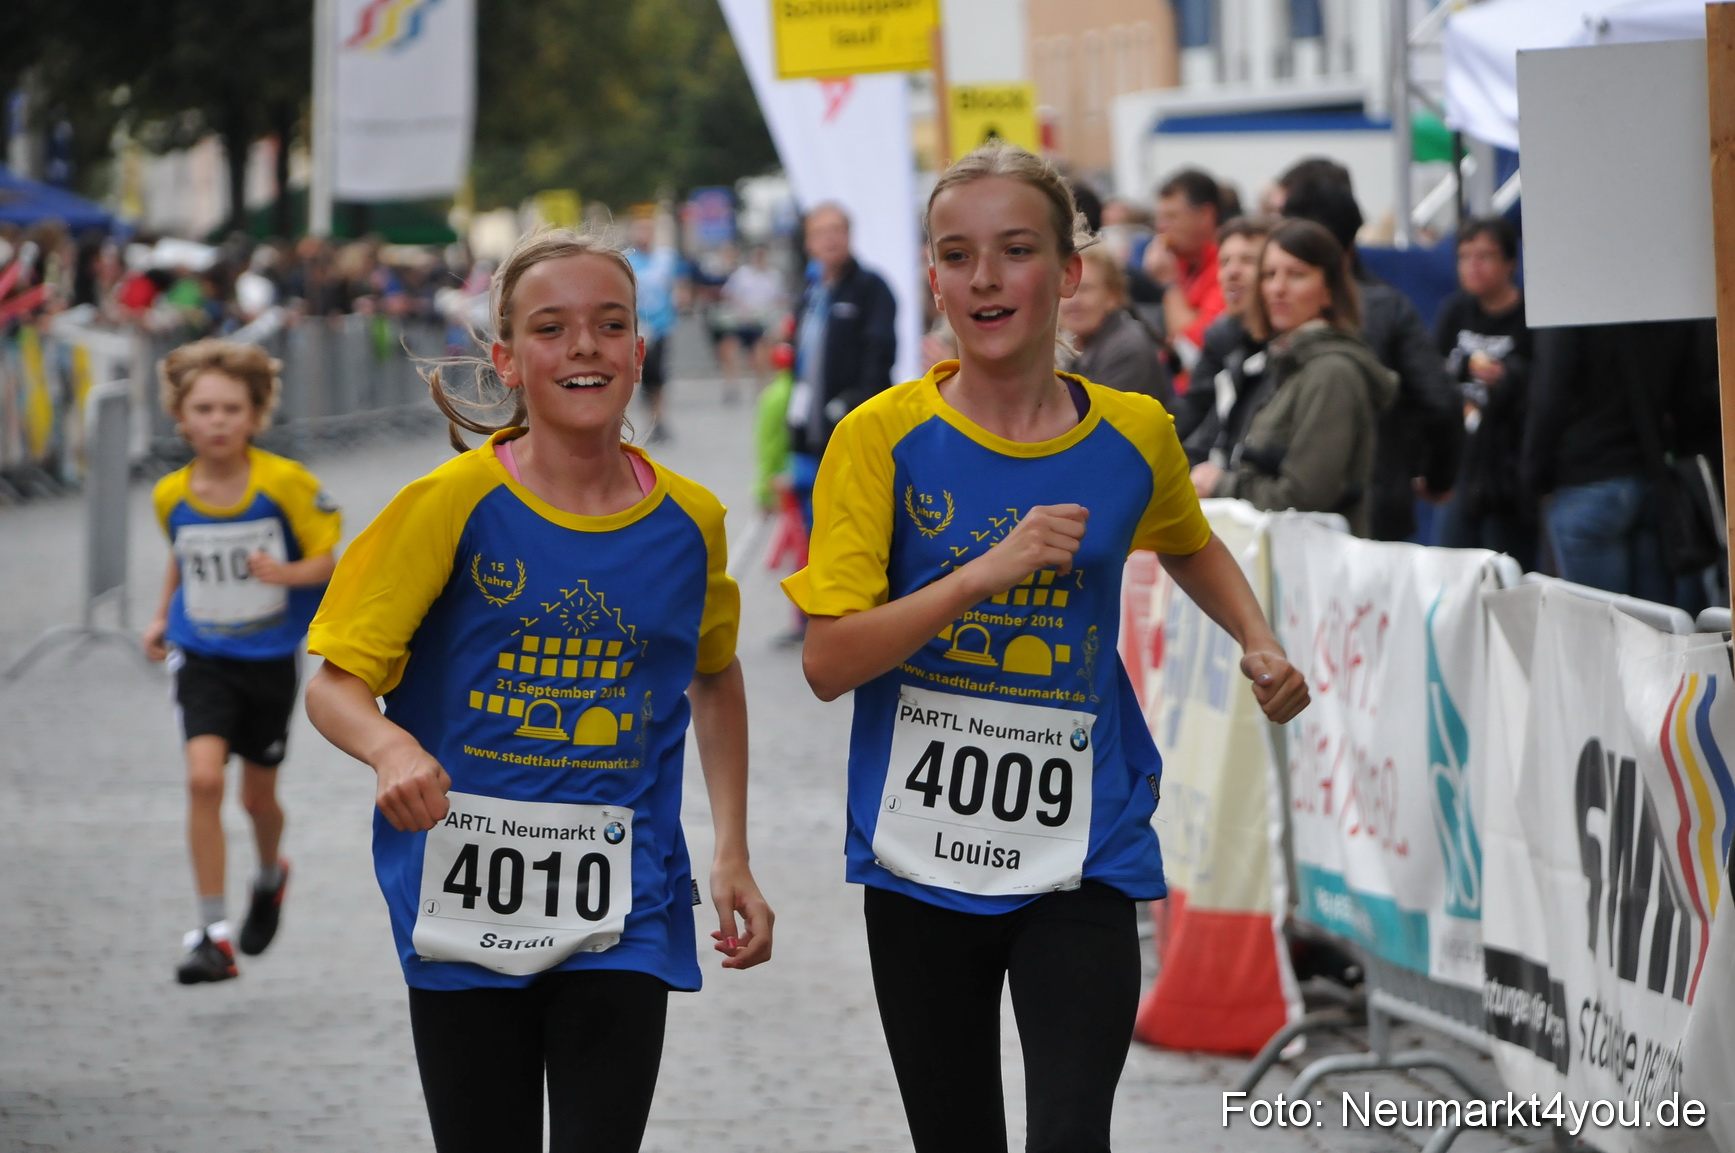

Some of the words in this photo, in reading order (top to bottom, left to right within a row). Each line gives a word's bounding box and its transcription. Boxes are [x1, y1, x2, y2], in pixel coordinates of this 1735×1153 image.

[918, 493, 933, 504] 15
[916, 505, 942, 519] Jahre
[491, 562, 505, 573] 15
[482, 573, 513, 588] Jahre
[958, 610, 1028, 627] ptember
[1030, 614, 1064, 629] 2014
[496, 678, 596, 699] 21.September
[900, 705, 963, 732] PARTL
[968, 717, 1063, 746] Neumarkt
[463, 744, 640, 769] www.stadtlauf-neumarkt.de
[905, 739, 1073, 827] 4009
[444, 811, 496, 834] ARTL
[501, 820, 596, 841] Neumarkt
[934, 831, 1021, 870] Louisa
[443, 843, 611, 921] 4010
